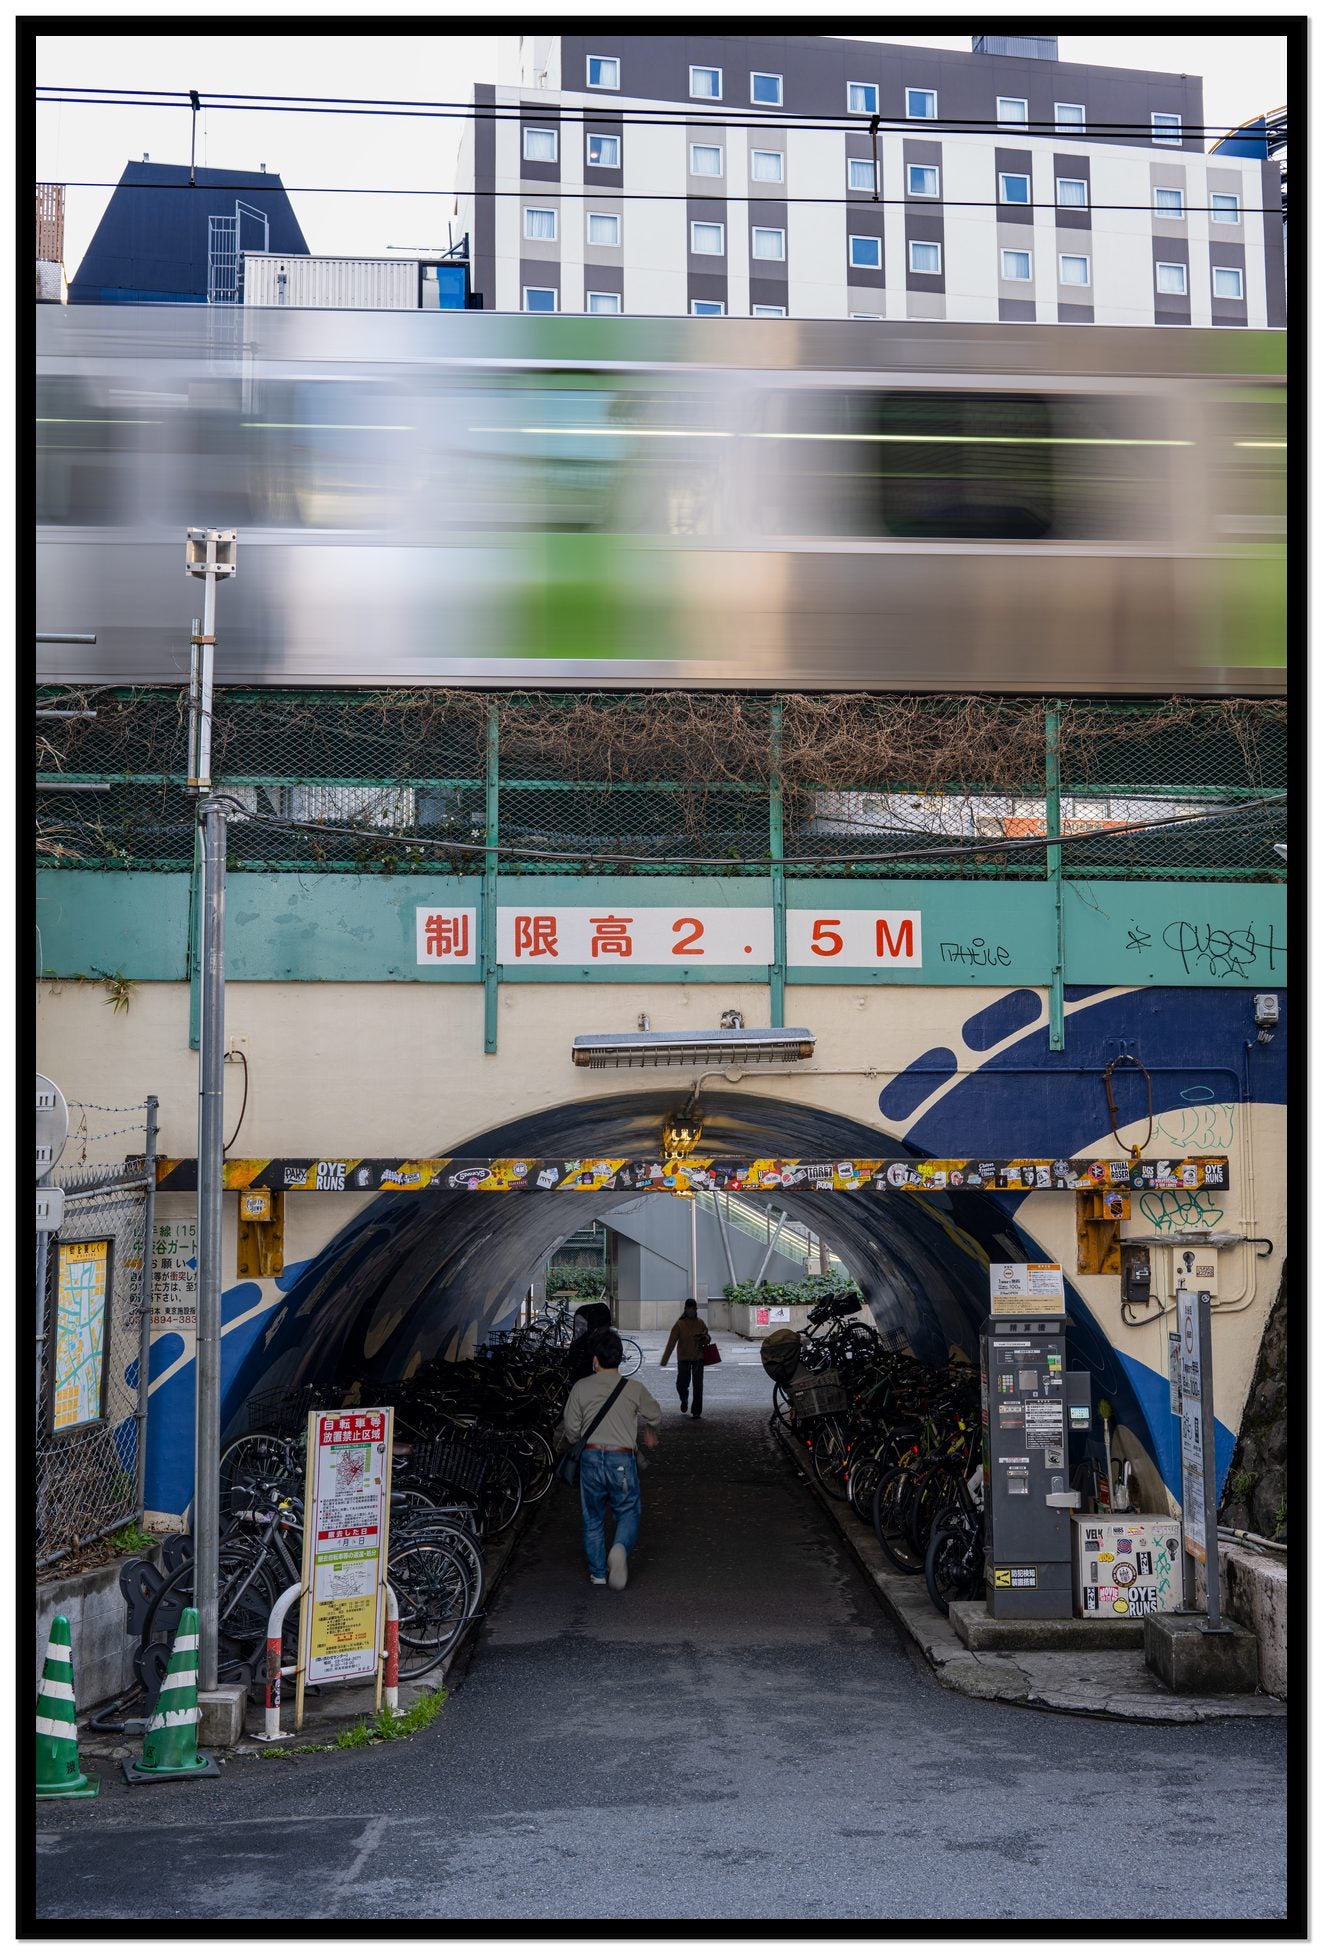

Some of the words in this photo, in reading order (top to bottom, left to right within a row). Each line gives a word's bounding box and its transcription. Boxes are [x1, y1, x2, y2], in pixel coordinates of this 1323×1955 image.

[317, 1162, 346, 1177] OYE
[1205, 1165, 1223, 1174] OYE
[316, 1176, 345, 1191] RUNS
[1205, 1173, 1223, 1183] RUNS
[1086, 1528, 1104, 1540] VELK
[1128, 1587, 1156, 1602] OYE
[1129, 1601, 1157, 1617] RUNS
